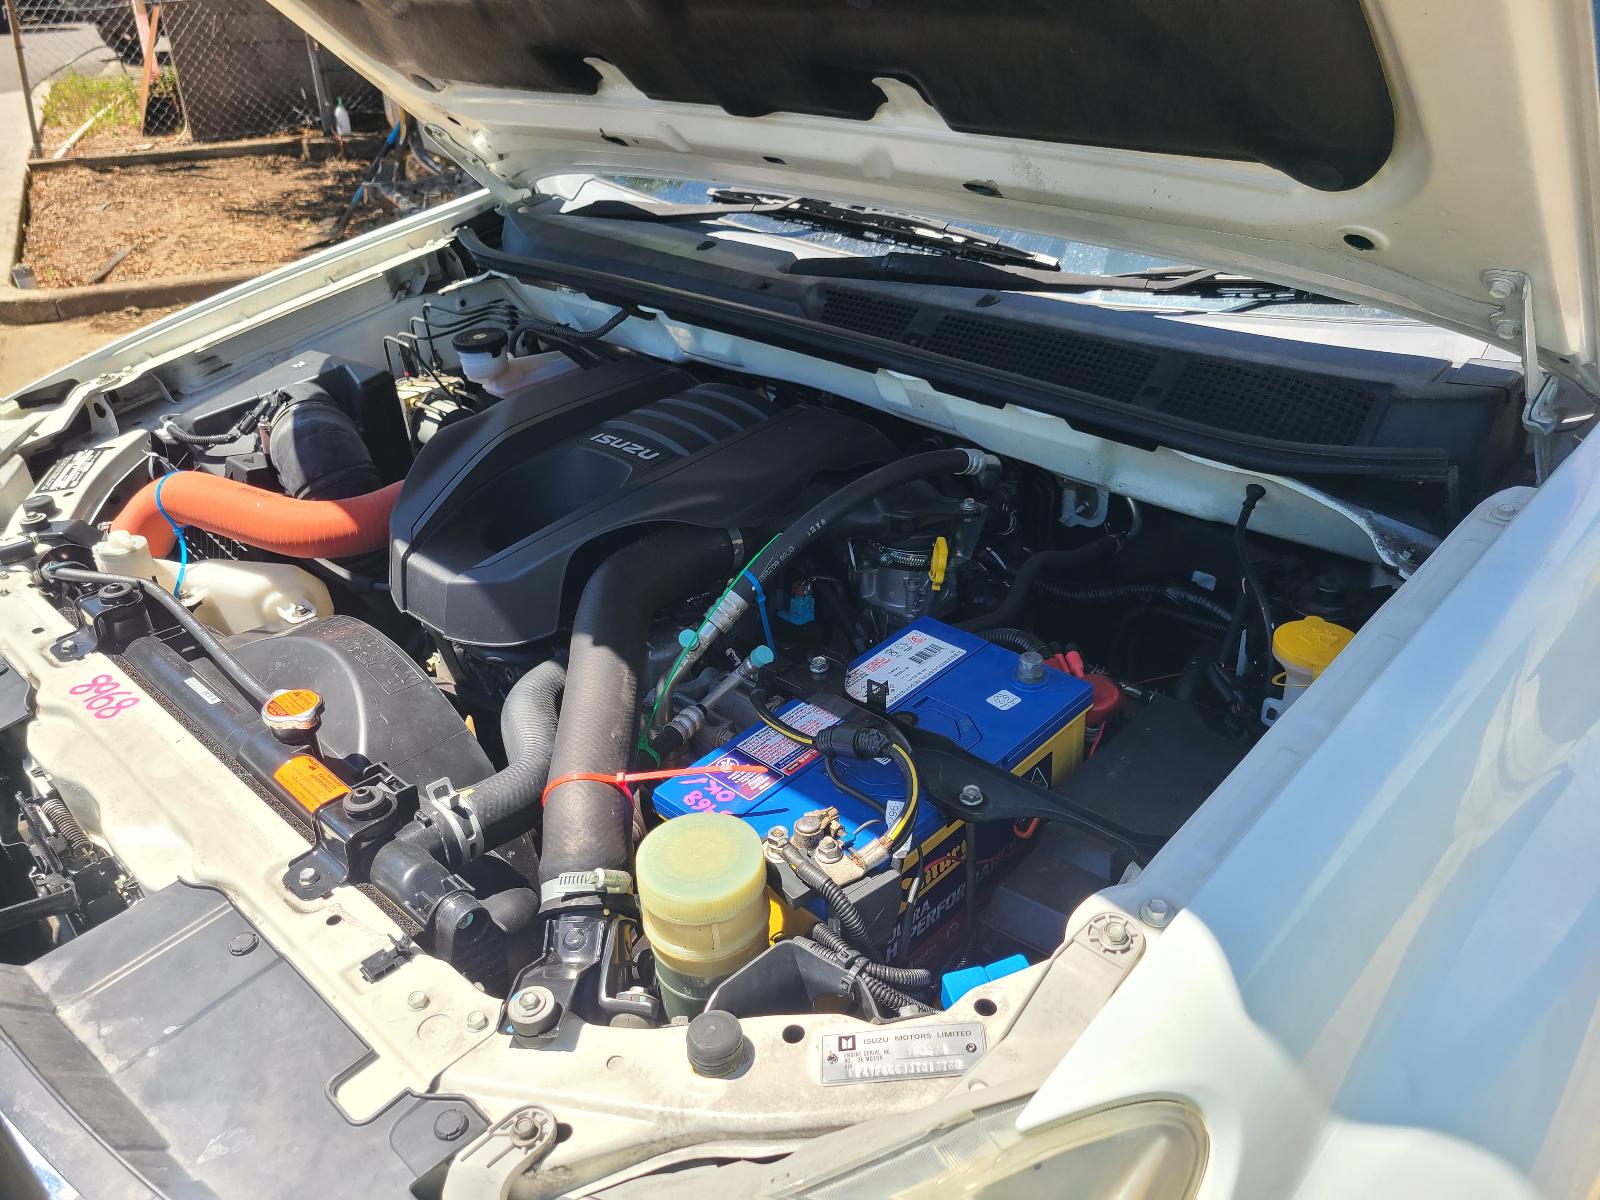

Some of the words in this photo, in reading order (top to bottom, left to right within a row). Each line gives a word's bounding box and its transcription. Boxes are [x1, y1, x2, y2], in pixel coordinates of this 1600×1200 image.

[590, 433, 660, 460] ISUZU
[863, 1037, 889, 1045] ISUZU
[894, 1032, 932, 1041] MOTORS
[937, 1030, 972, 1039] LIMITED
